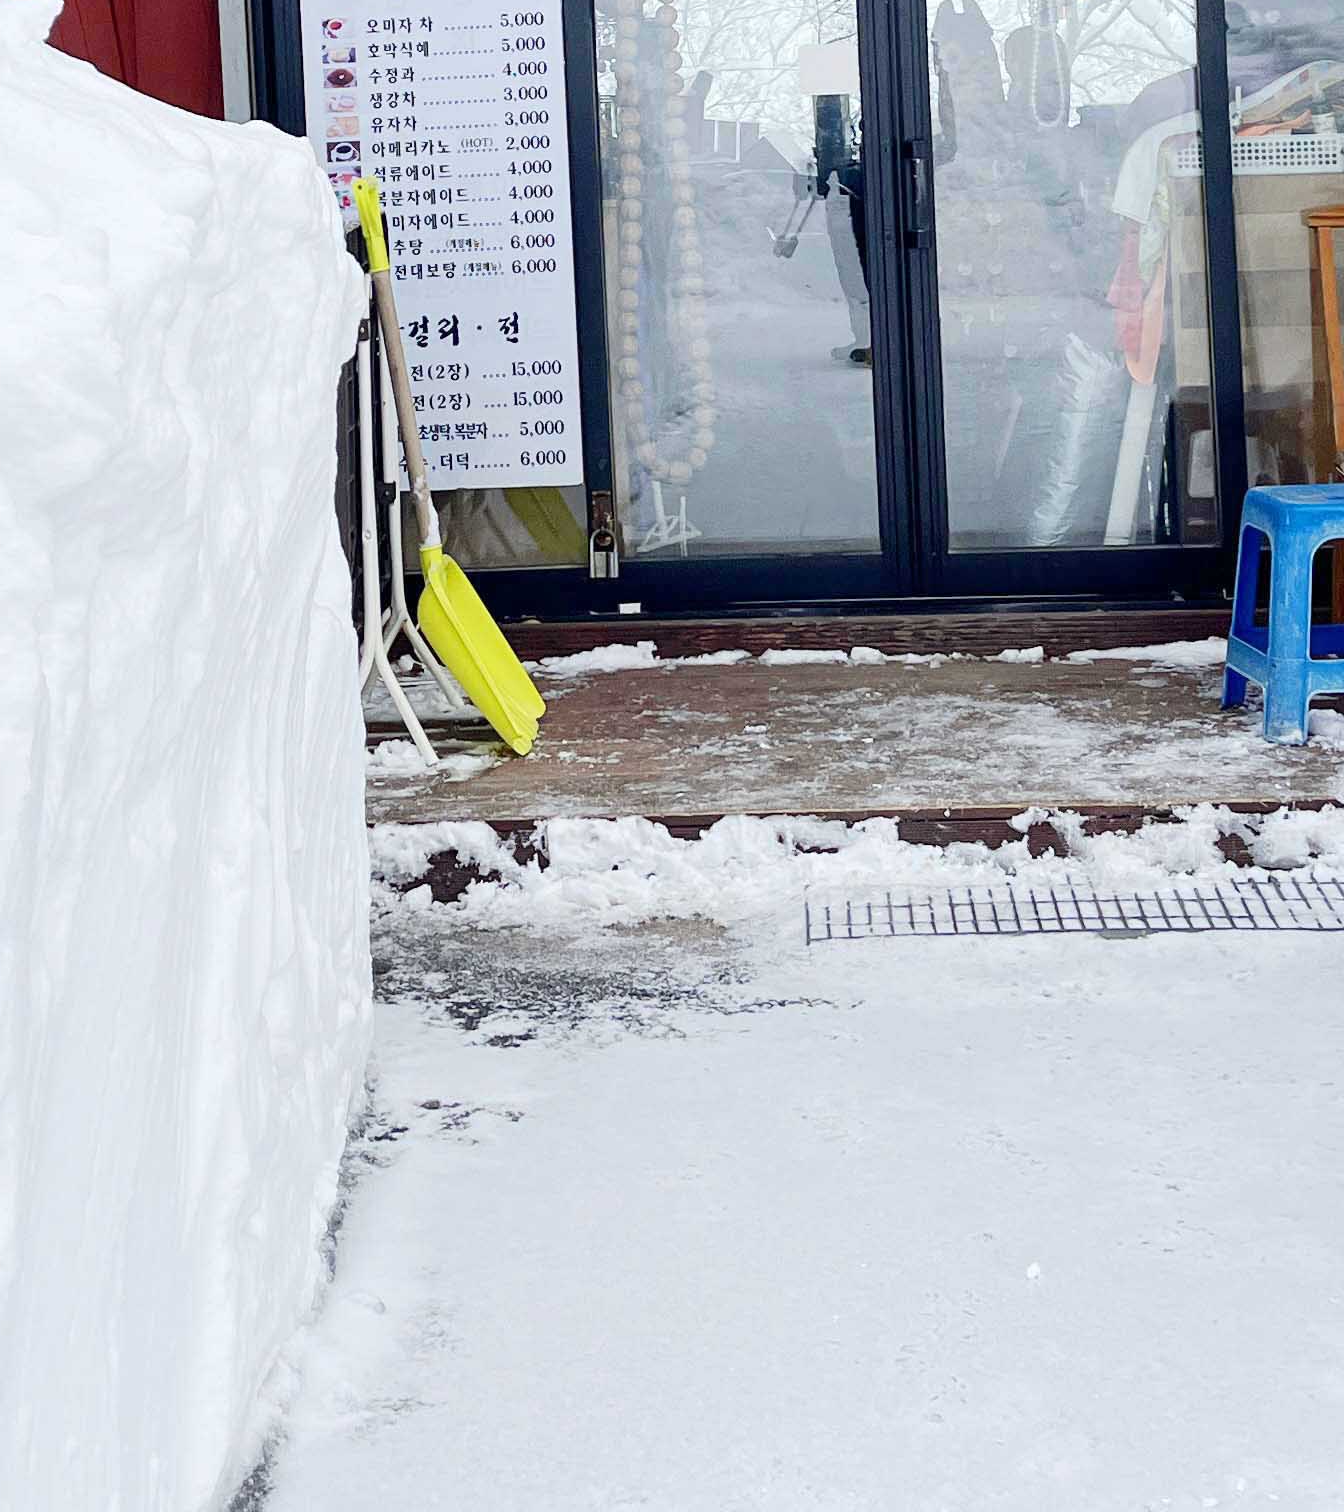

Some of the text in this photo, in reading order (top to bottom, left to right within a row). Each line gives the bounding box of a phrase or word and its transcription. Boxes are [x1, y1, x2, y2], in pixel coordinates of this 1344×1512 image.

[500, 11, 545, 28] 5,000
[501, 36, 546, 53] 5,000
[369, 61, 548, 85] 수정과 4,000
[369, 85, 548, 109] 생강차 3,000
[371, 110, 549, 134] 유자차 3,000
[371, 139, 451, 158] 아메리카노
[505, 135, 551, 151] 2,000
[374, 159, 552, 183] 석류에이드 4,000
[508, 184, 554, 201] 4,000
[392, 208, 555, 232] 미자에이드 4,000
[393, 239, 423, 256] 추탕
[510, 233, 556, 250] 6,000
[394, 262, 457, 281] 전대보탕
[511, 258, 557, 275] 6,000
[400, 311, 519, 348] 걸리 전
[410, 359, 562, 382] 전(2장) 15,000
[412, 389, 564, 412] 전(2장) 15,000
[417, 421, 488, 442] 초생탁,복분자
[519, 419, 565, 438] 5,000
[440, 452, 469, 471] 더덕
[520, 449, 567, 467] 6,000
